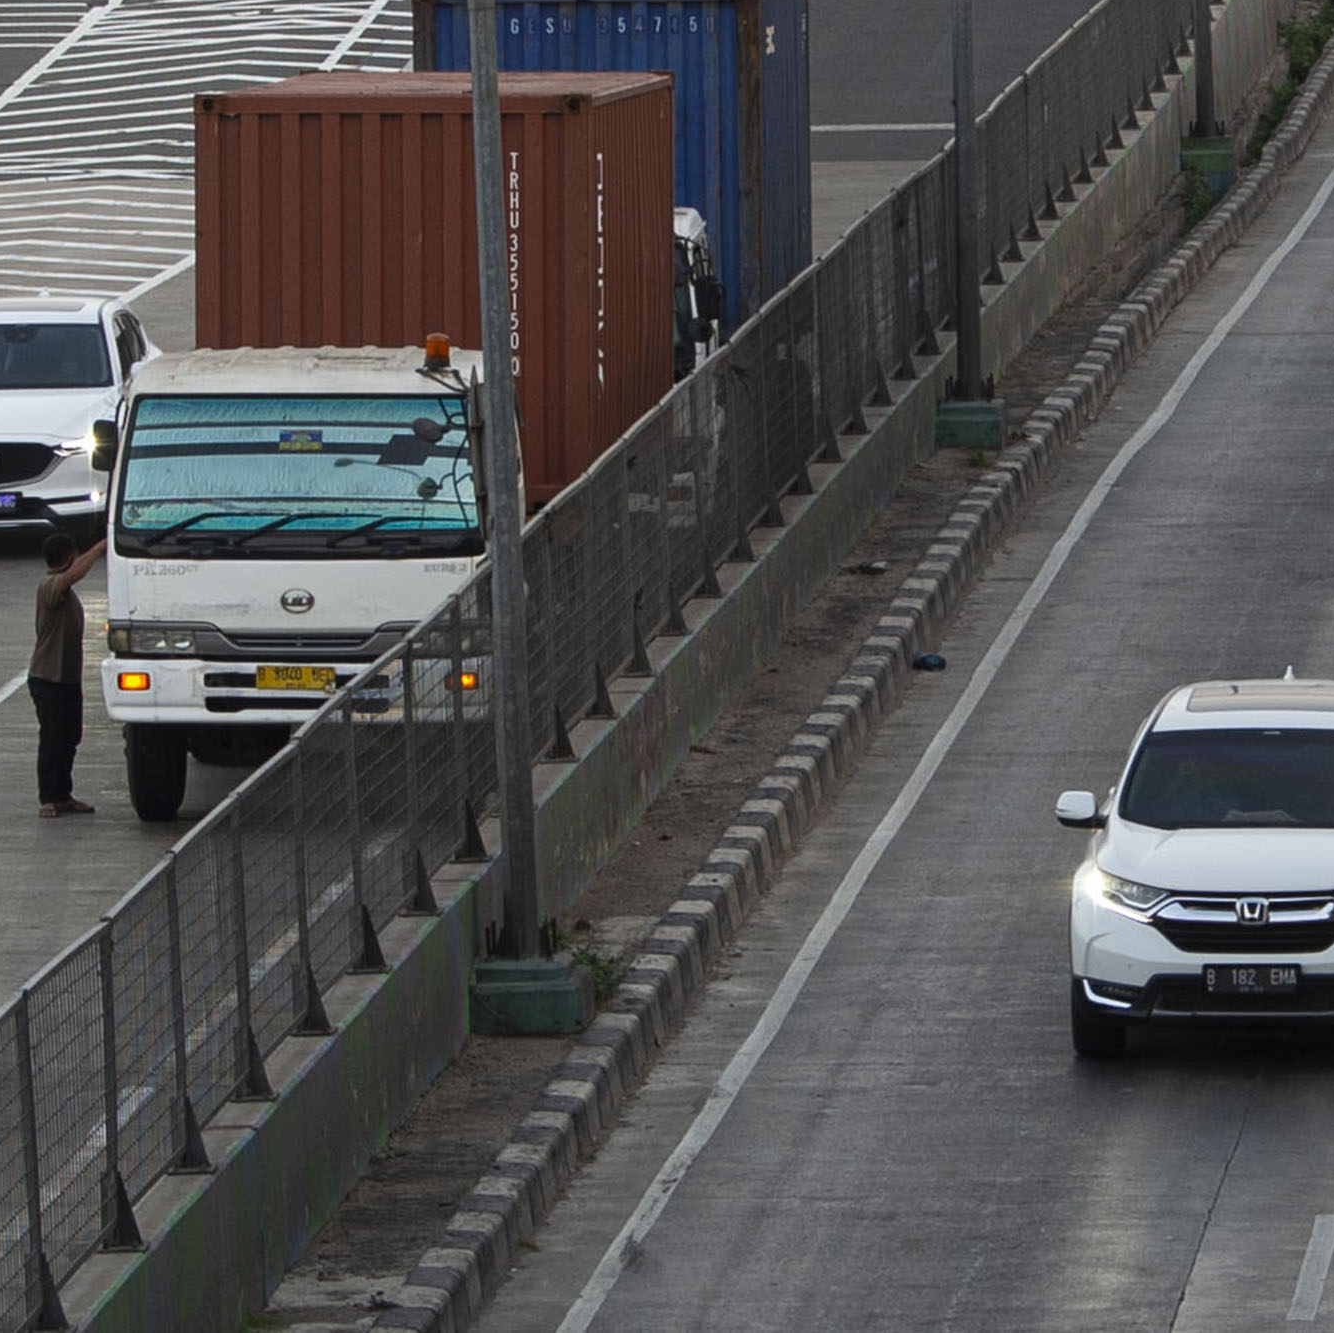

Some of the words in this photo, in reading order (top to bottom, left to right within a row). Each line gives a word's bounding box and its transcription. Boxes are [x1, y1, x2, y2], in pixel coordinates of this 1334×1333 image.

[510, 17, 573, 35] GESU
[509, 152, 519, 228] TRHU
[509, 234, 519, 350] 355150
[1207, 969, 1215, 985] B
[1232, 969, 1257, 985] 182
[1270, 969, 1297, 985] EMA
